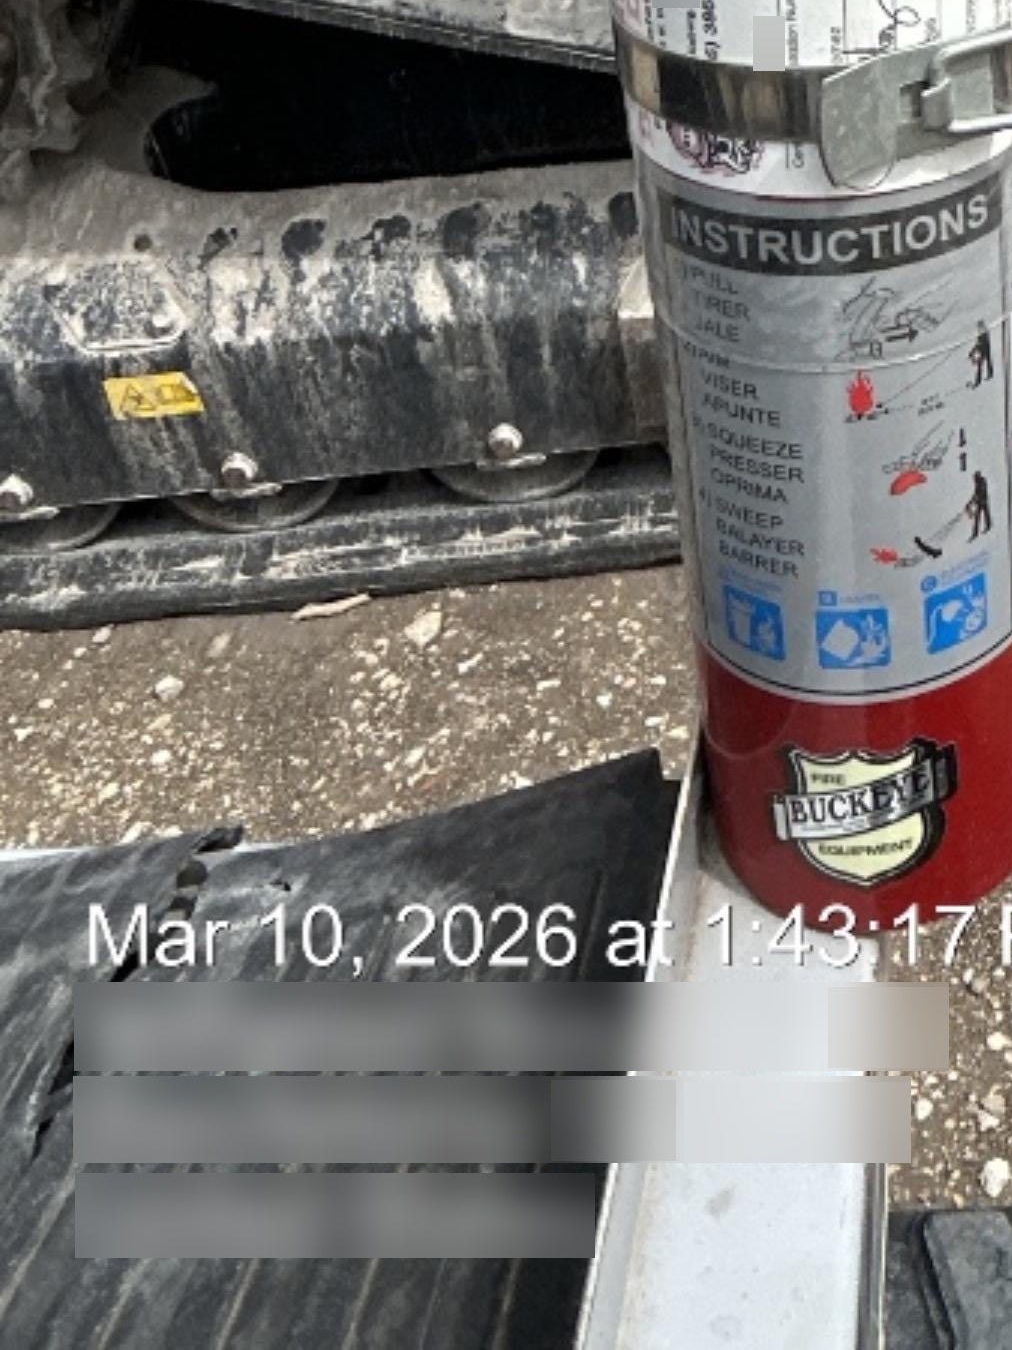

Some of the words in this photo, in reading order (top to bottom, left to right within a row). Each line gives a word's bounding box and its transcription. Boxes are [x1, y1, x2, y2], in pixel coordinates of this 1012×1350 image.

[670, 193, 989, 266] INSTRUCTIONS
[707, 422, 805, 461] SQUEEZE
[710, 444, 806, 484] PRESSER
[710, 467, 789, 504] OPRIMA
[715, 497, 784, 530] SWEEP
[715, 516, 806, 557] BALAYER
[718, 539, 800, 579] BARRER
[790, 766, 930, 824] BUCKEYE
[818, 836, 913, 856] EQUIPMENT
